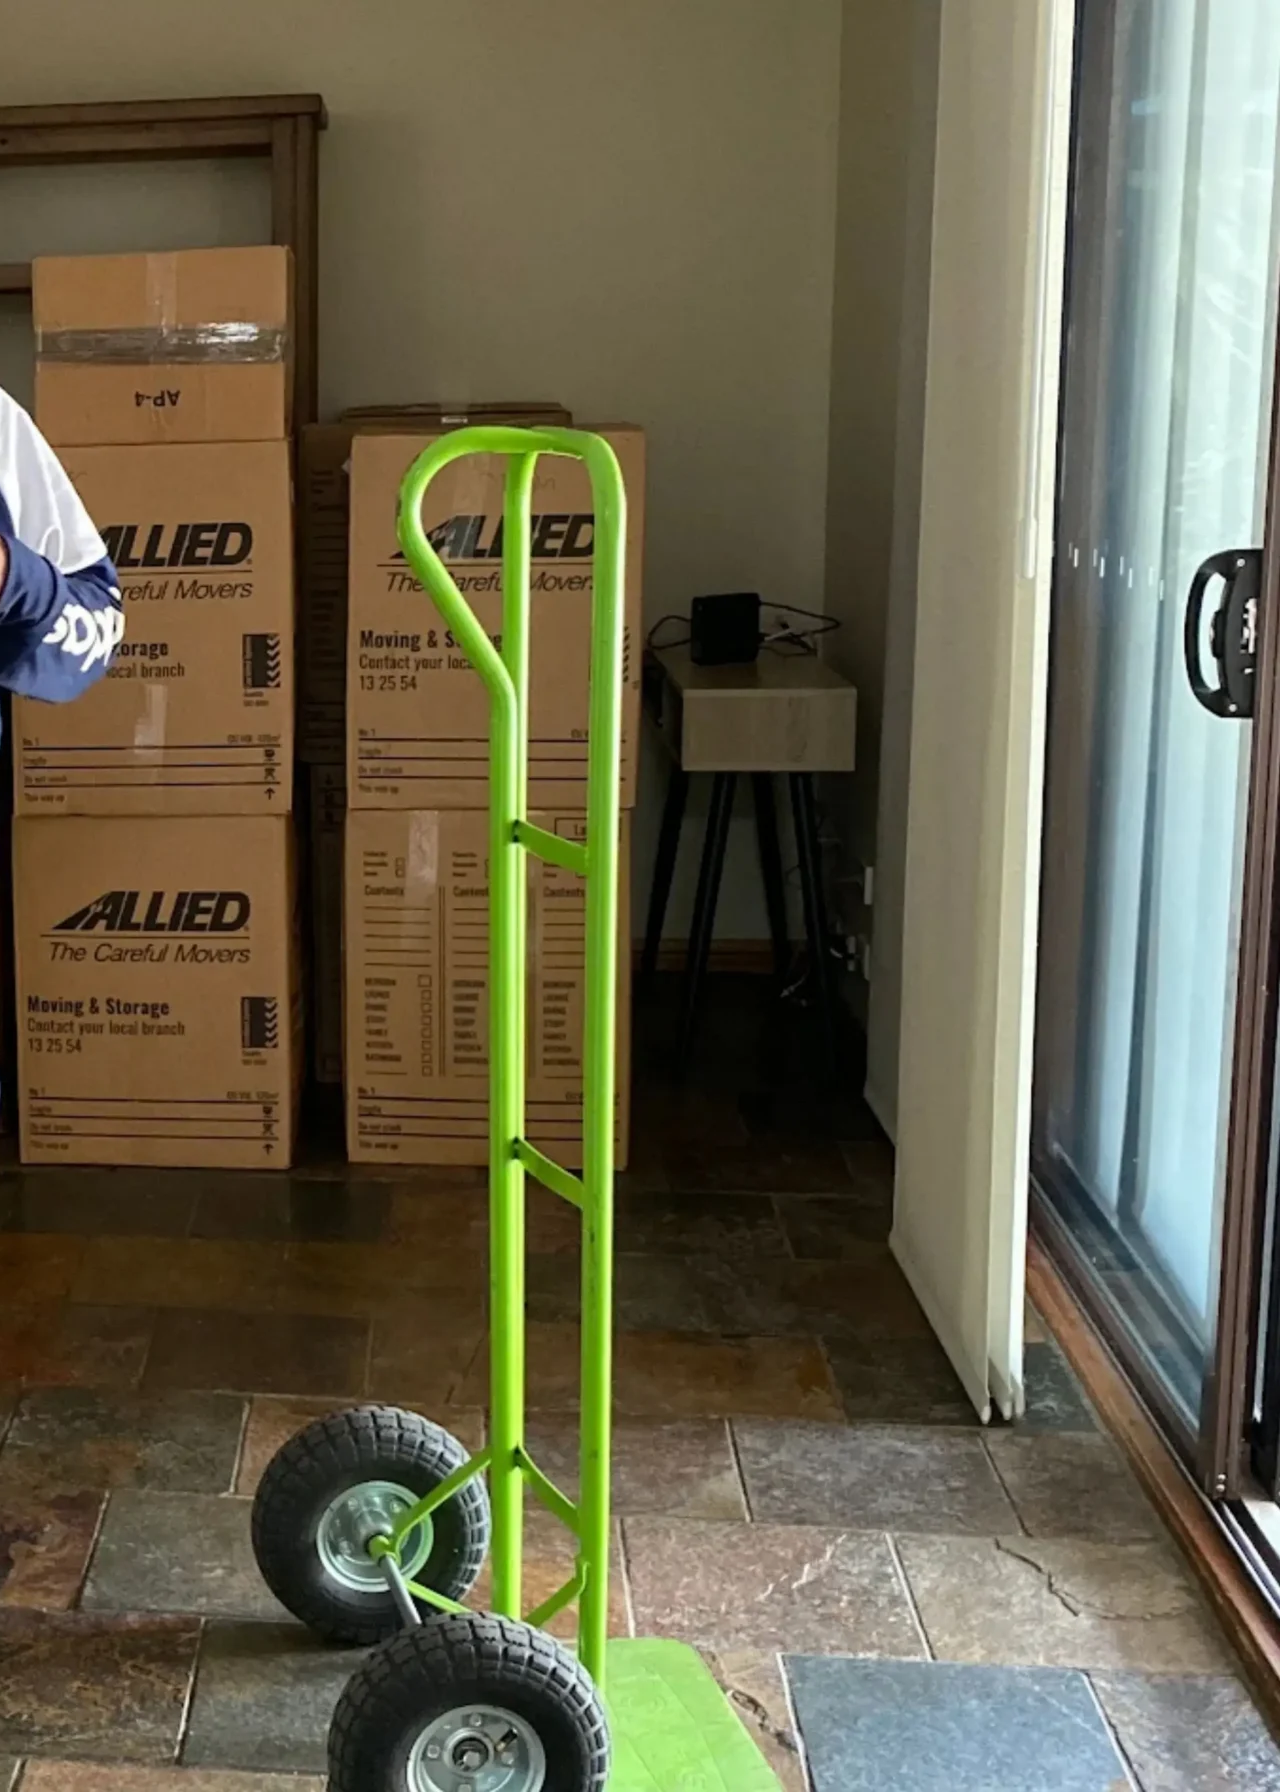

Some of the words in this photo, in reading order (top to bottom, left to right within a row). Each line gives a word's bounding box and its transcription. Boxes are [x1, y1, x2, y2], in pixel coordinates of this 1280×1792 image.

[135, 390, 180, 408] AP-4
[121, 579, 168, 600] reful
[174, 579, 253, 600] Movers
[386, 572, 424, 592] The
[360, 630, 421, 652] Moving
[427, 630, 438, 648] &
[119, 642, 169, 660] orage
[141, 661, 185, 678] branch
[359, 654, 410, 669] Contact
[414, 658, 442, 671] your
[448, 655, 476, 670] loca
[360, 676, 374, 690] 13
[379, 676, 396, 690] 25
[400, 676, 417, 691] 54
[52, 891, 250, 932] ALLIED
[50, 942, 87, 962] The
[94, 943, 168, 963] Careful
[174, 944, 251, 964] Movers
[28, 996, 84, 1017] Moving
[90, 997, 100, 1014] &
[106, 998, 169, 1019] Storage
[28, 1018, 74, 1033] Contact
[79, 1022, 104, 1036] your
[110, 1020, 138, 1034] local
[142, 1022, 185, 1036] branch
[28, 1038, 42, 1053] 13
[47, 1038, 62, 1053] 25
[66, 1038, 82, 1053] 54
